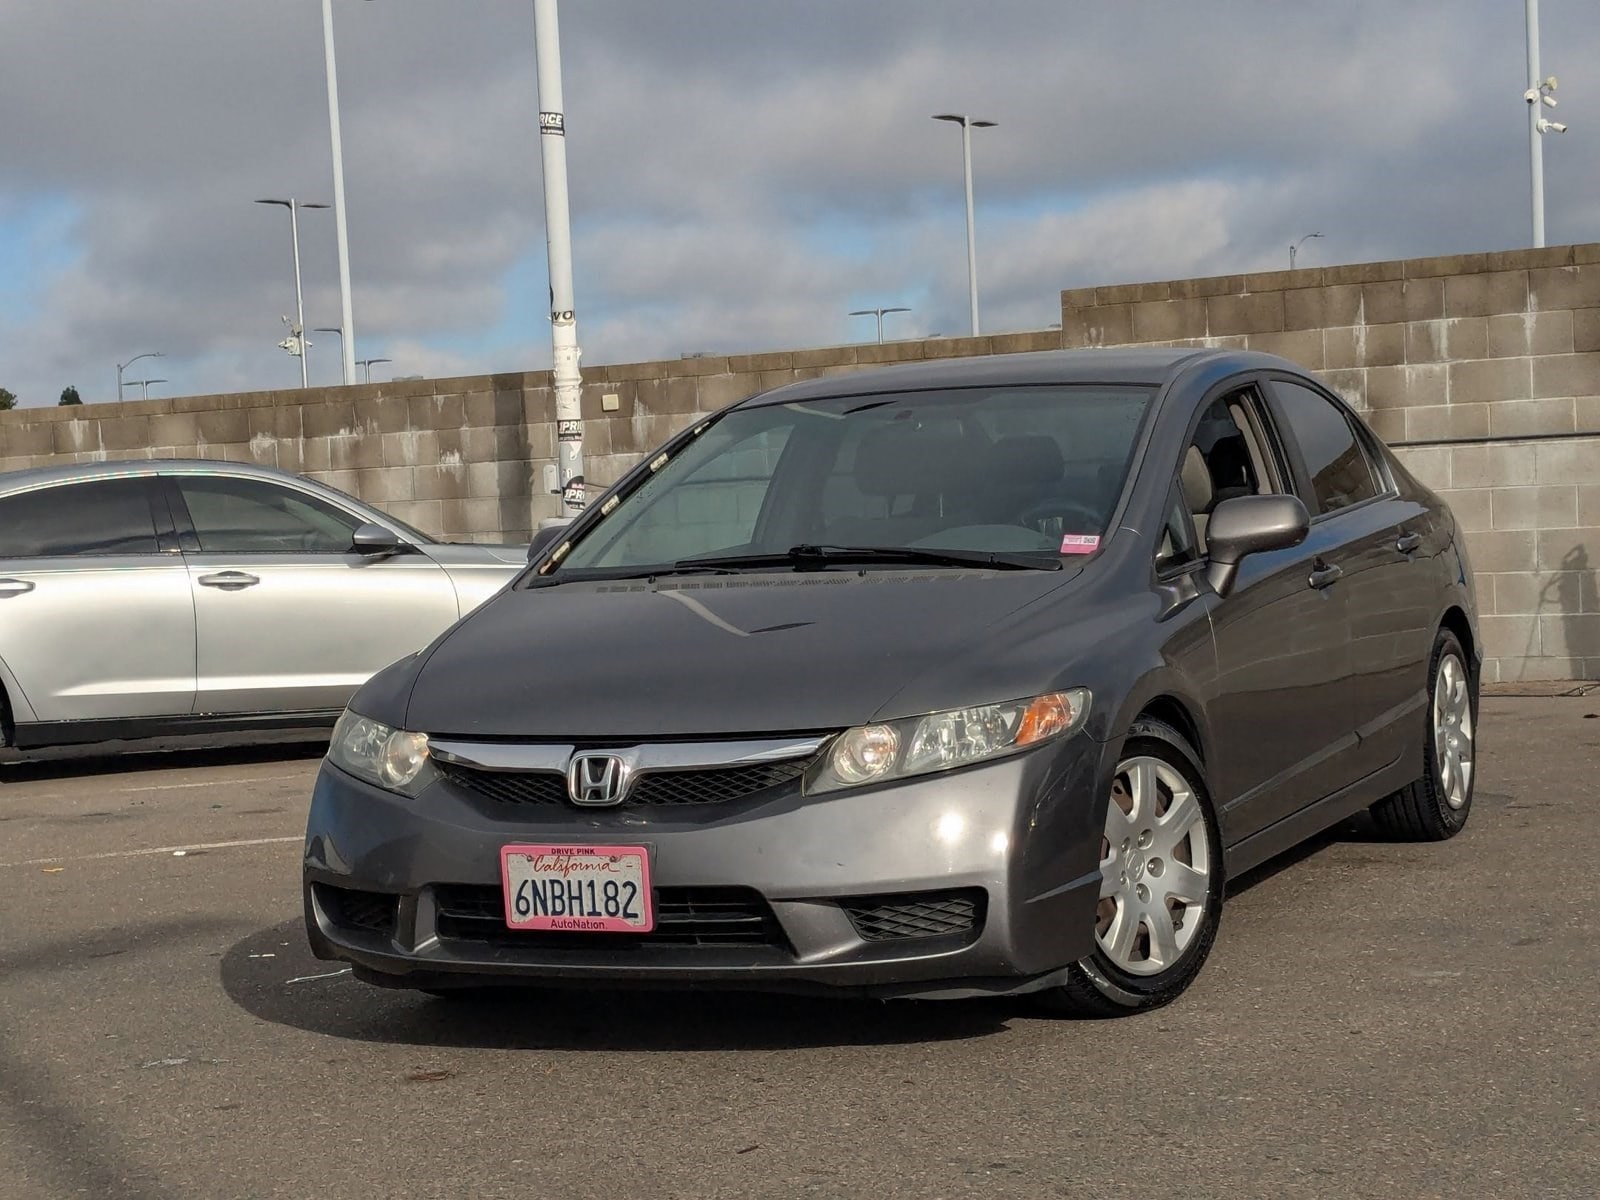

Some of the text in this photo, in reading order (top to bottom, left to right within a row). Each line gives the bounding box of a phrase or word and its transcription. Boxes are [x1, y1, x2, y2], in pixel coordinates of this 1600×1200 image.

[564, 488, 585, 500] 1PR
[551, 847, 596, 856] DRIVE PINK
[533, 854, 620, 878] California
[515, 879, 639, 919] 6NBH182
